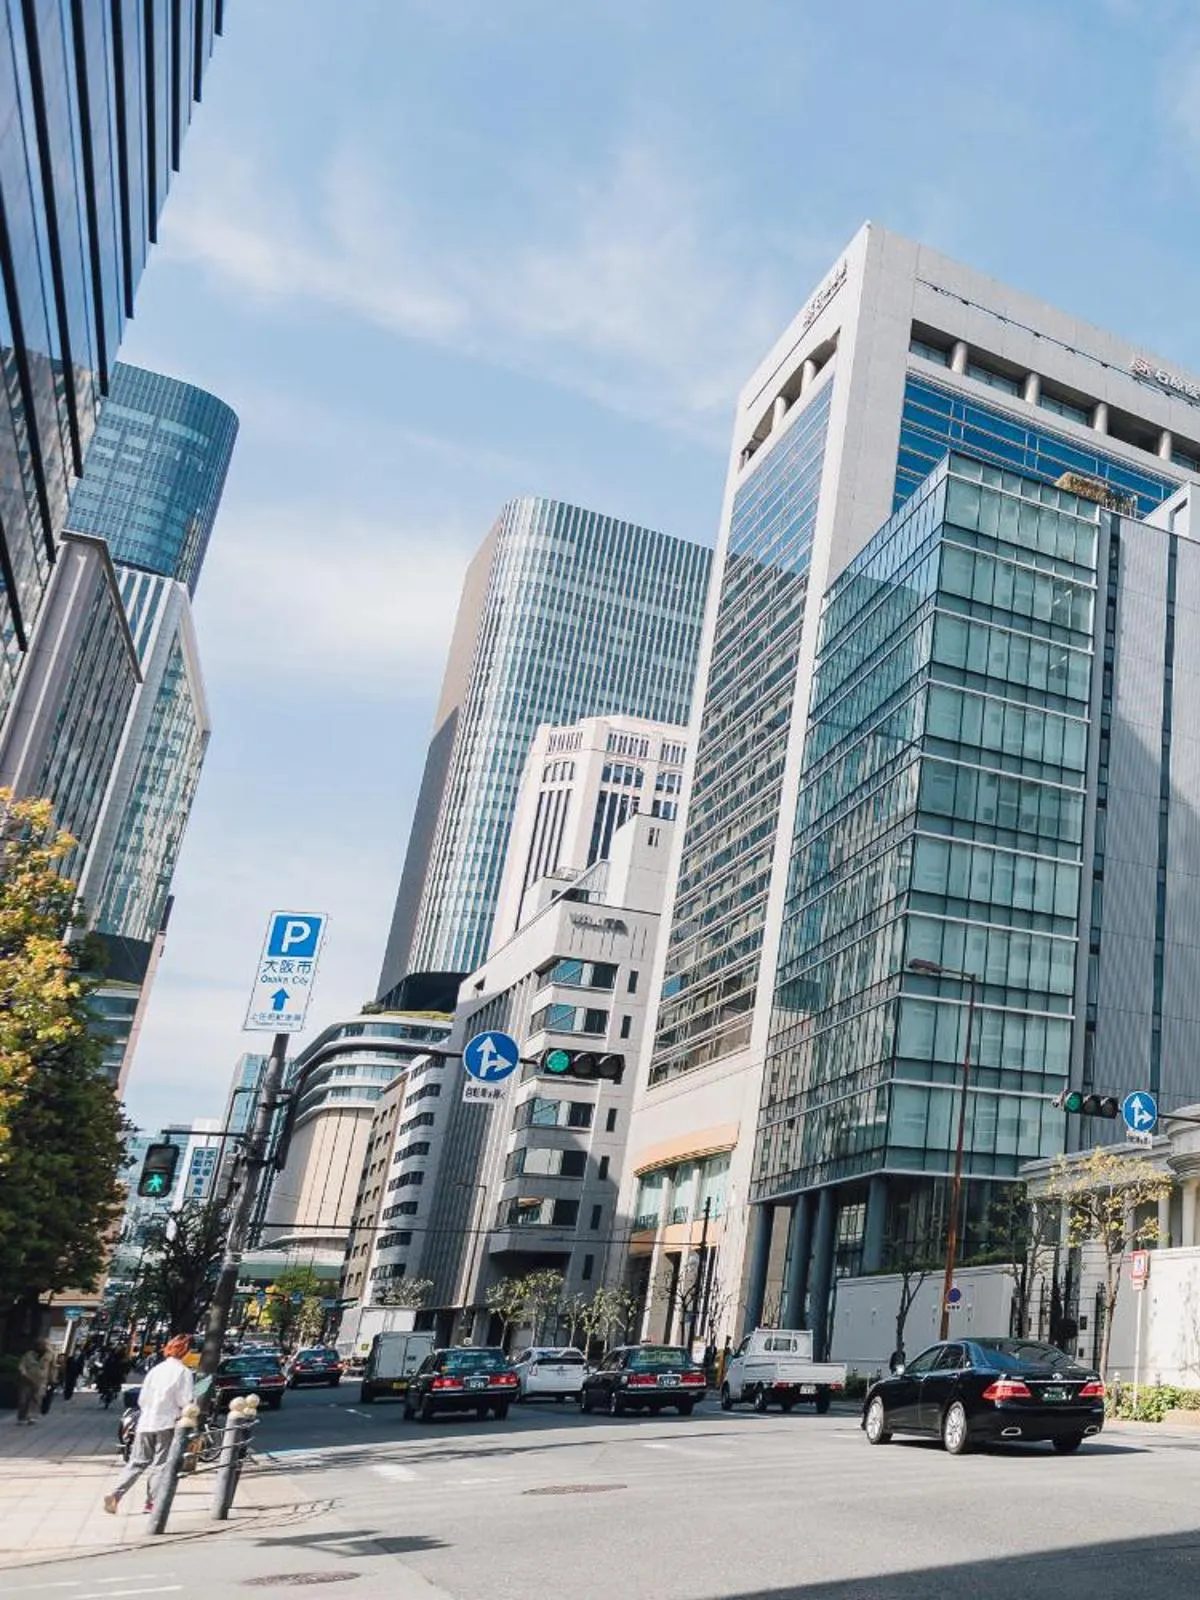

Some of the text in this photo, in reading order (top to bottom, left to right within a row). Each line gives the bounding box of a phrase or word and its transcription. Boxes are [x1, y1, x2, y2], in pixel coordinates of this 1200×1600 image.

[281, 920, 312, 953] P
[262, 960, 313, 974] 大阪市
